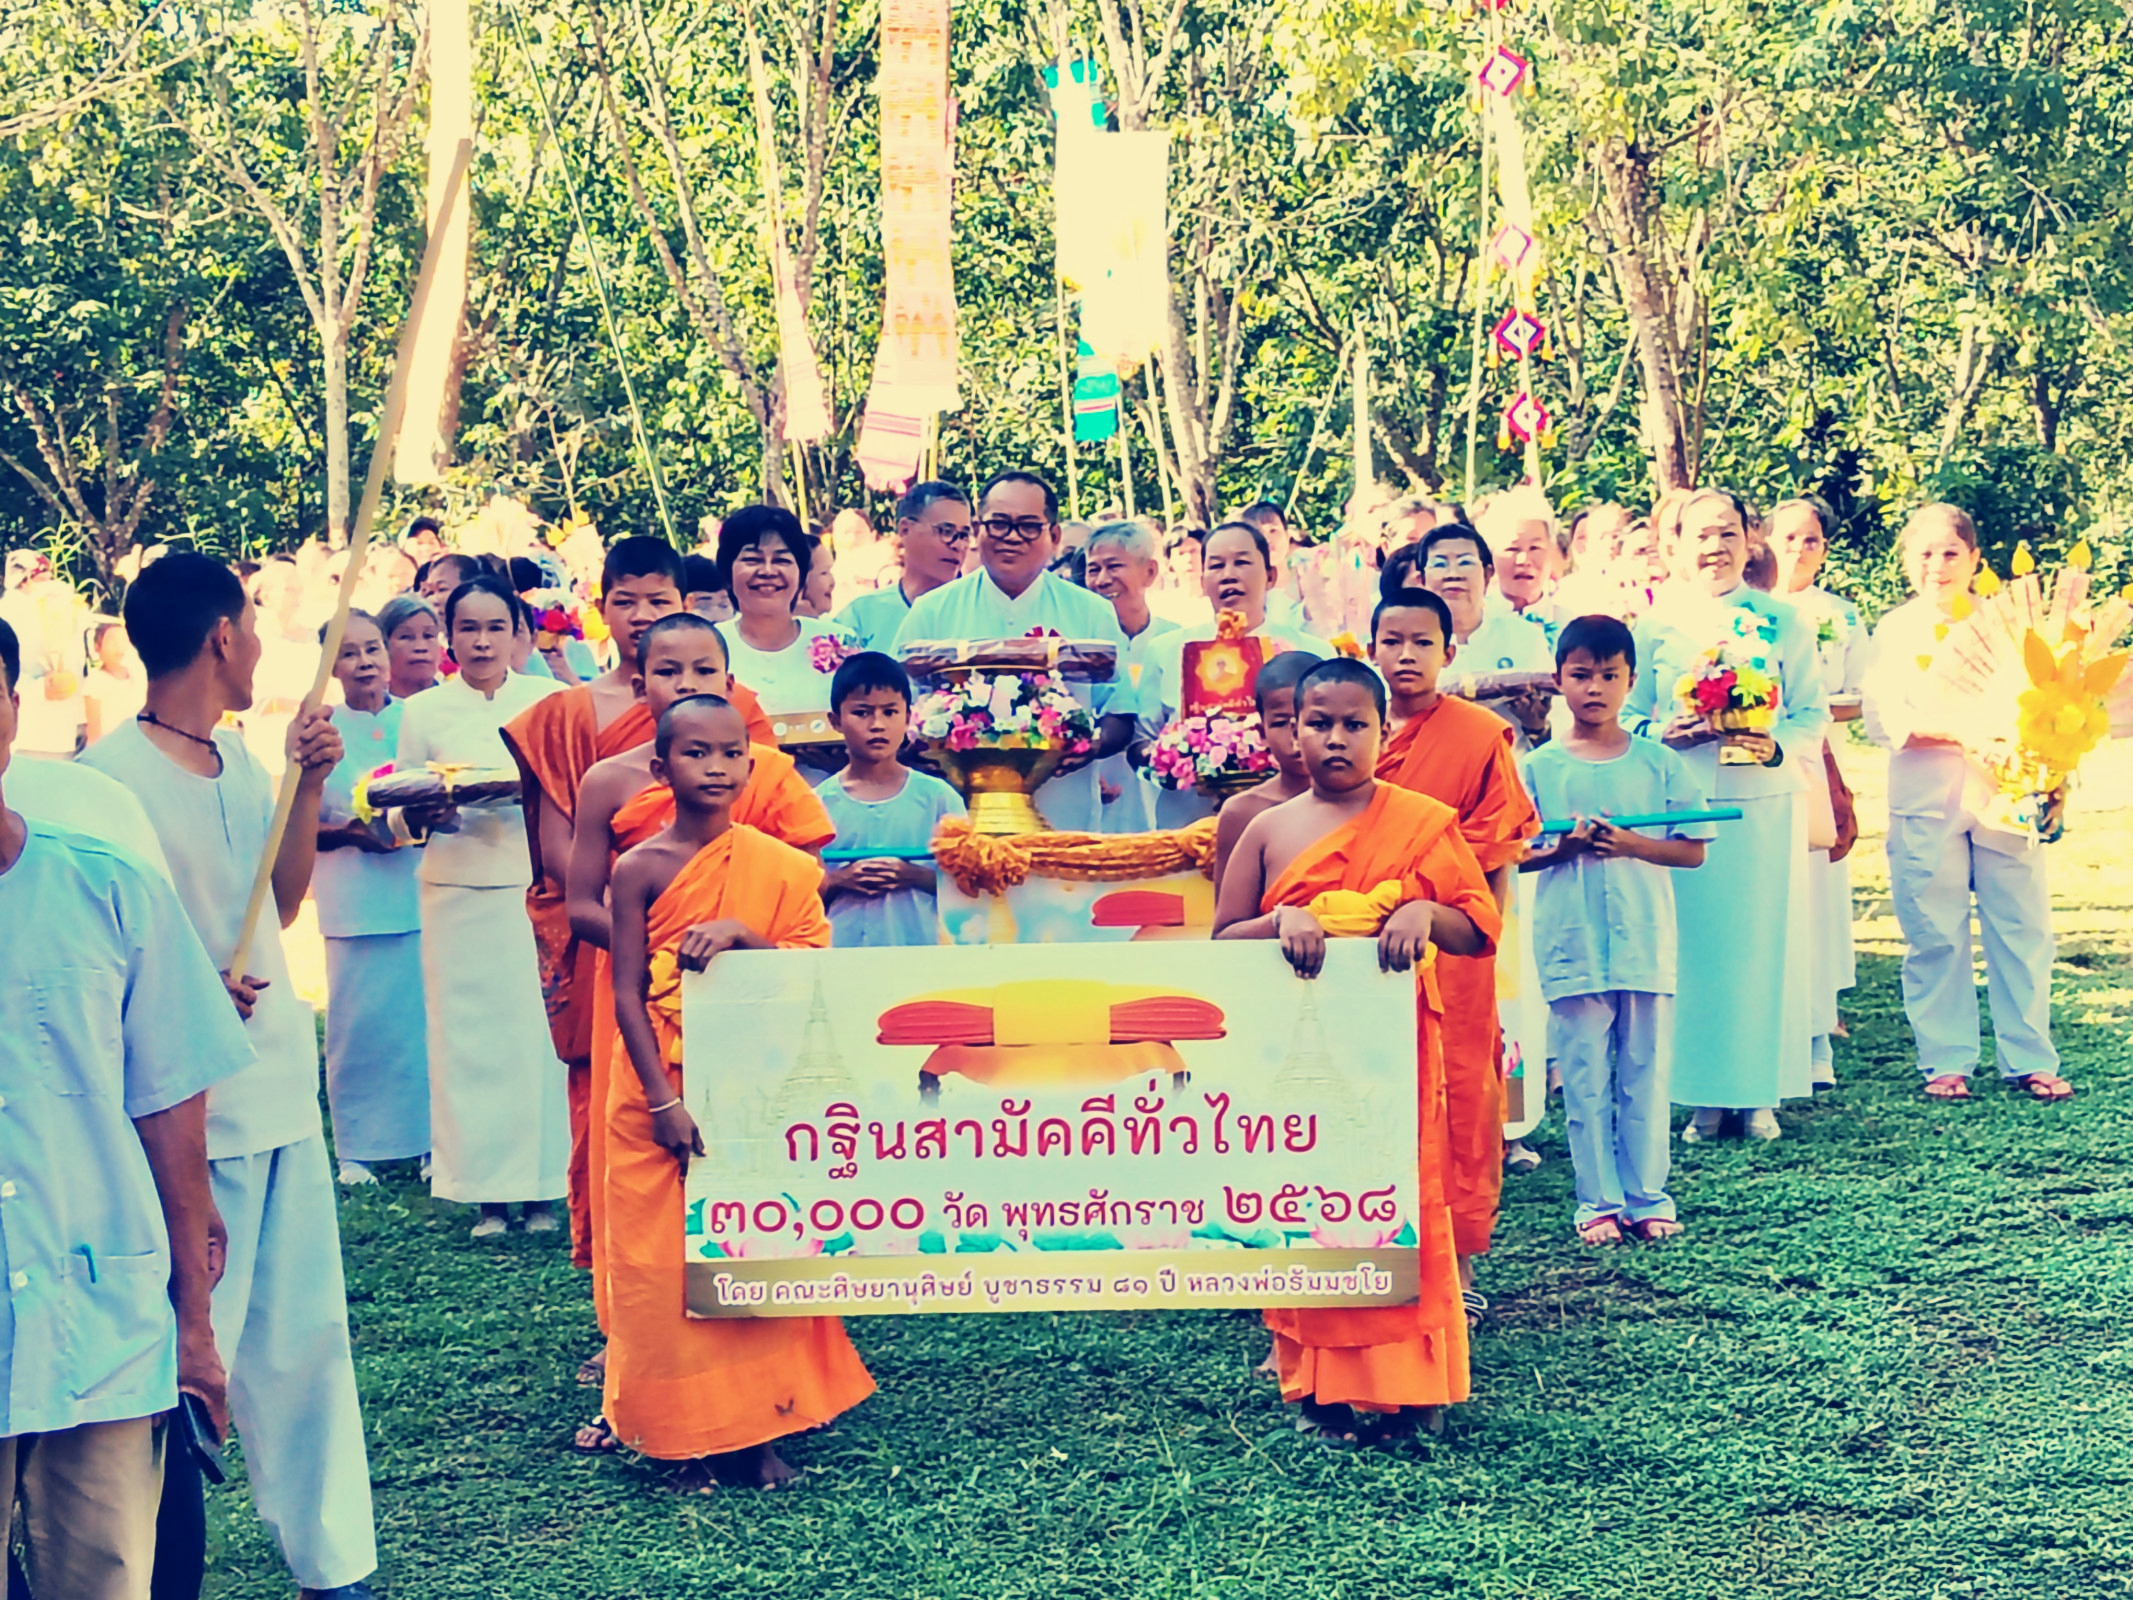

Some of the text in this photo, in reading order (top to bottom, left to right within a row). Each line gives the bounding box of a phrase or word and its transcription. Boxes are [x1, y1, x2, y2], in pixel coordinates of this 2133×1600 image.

[785, 1078, 1317, 1180] กฐินสามัคคีทั่วไทย
[943, 1191, 988, 1228] วัด
[1002, 1187, 1205, 1242] พุทธศักราช
[1222, 1183, 1398, 1225] ๒๕๖๘
[718, 1266, 1389, 1305] โดย คณะศิษยานุศิษย์ บูชาธรรม ๘๑ ปี หลวงพ่อธัมมชโย
